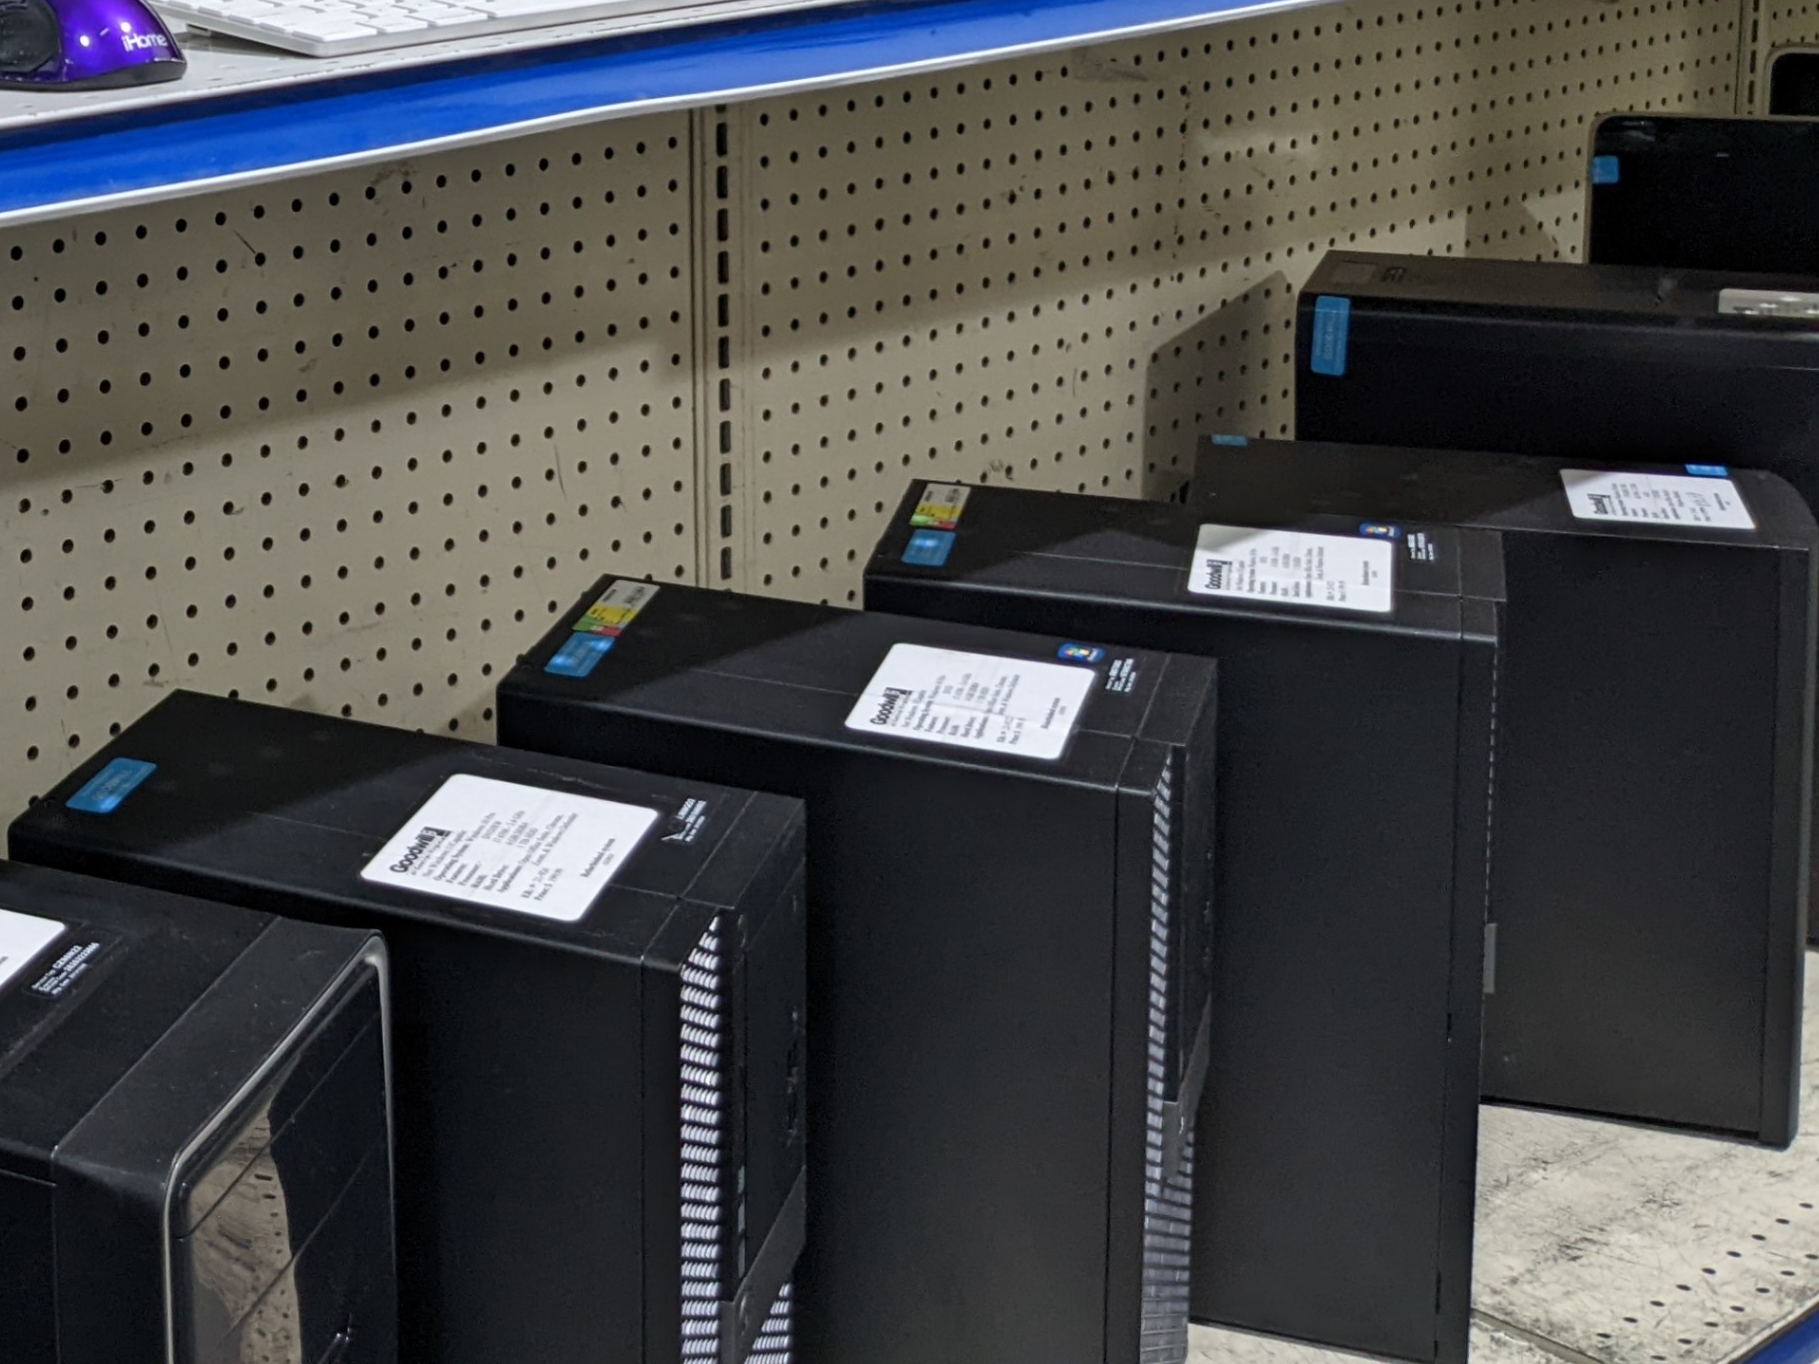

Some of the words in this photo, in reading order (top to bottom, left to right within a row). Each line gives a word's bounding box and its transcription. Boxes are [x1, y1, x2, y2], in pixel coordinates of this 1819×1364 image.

[122, 34, 168, 51] iHome
[869, 692, 900, 725] Goodwill
[389, 833, 435, 873] Goodwill
